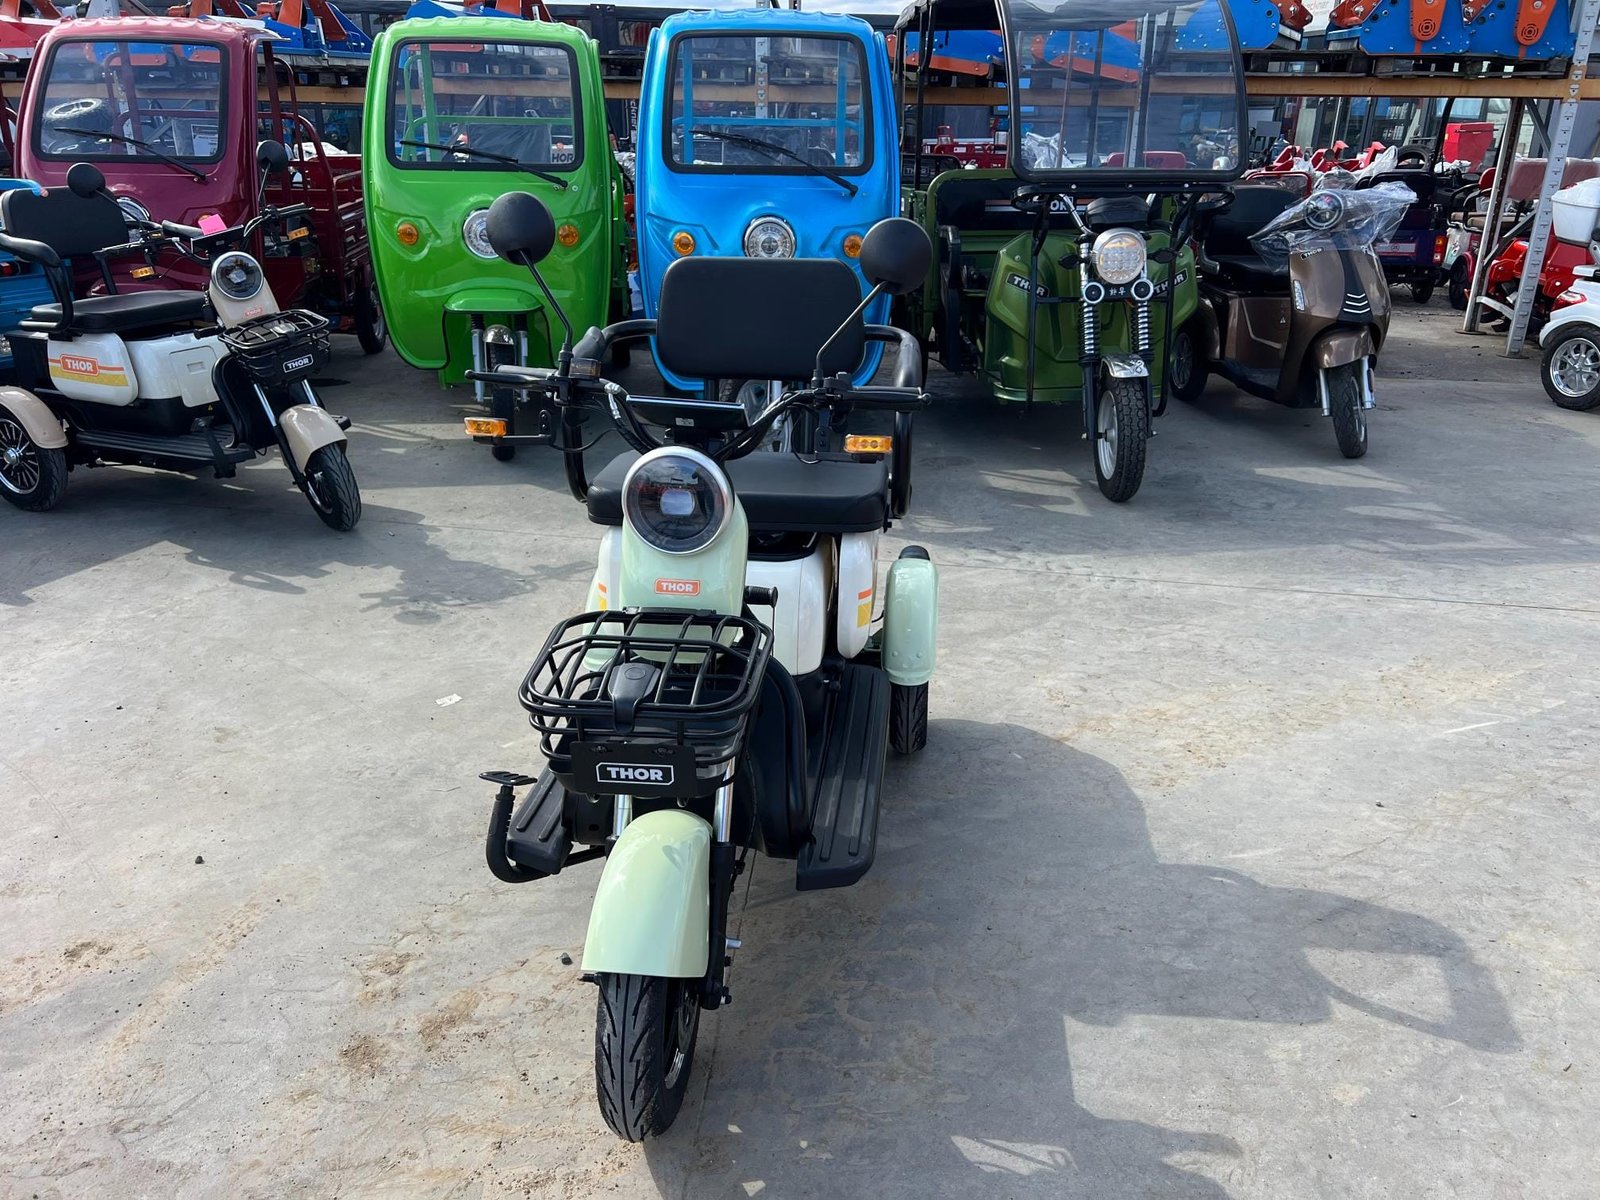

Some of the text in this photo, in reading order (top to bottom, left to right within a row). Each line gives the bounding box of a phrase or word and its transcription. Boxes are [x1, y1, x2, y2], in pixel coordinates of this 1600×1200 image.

[551, 153, 574, 163] HOR
[1013, 276, 1045, 296] THR
[1154, 273, 1184, 294] THR
[65, 358, 93, 372] THOR
[287, 357, 309, 369] THOR
[661, 582, 693, 592] THOR
[606, 766, 664, 781] THOR
